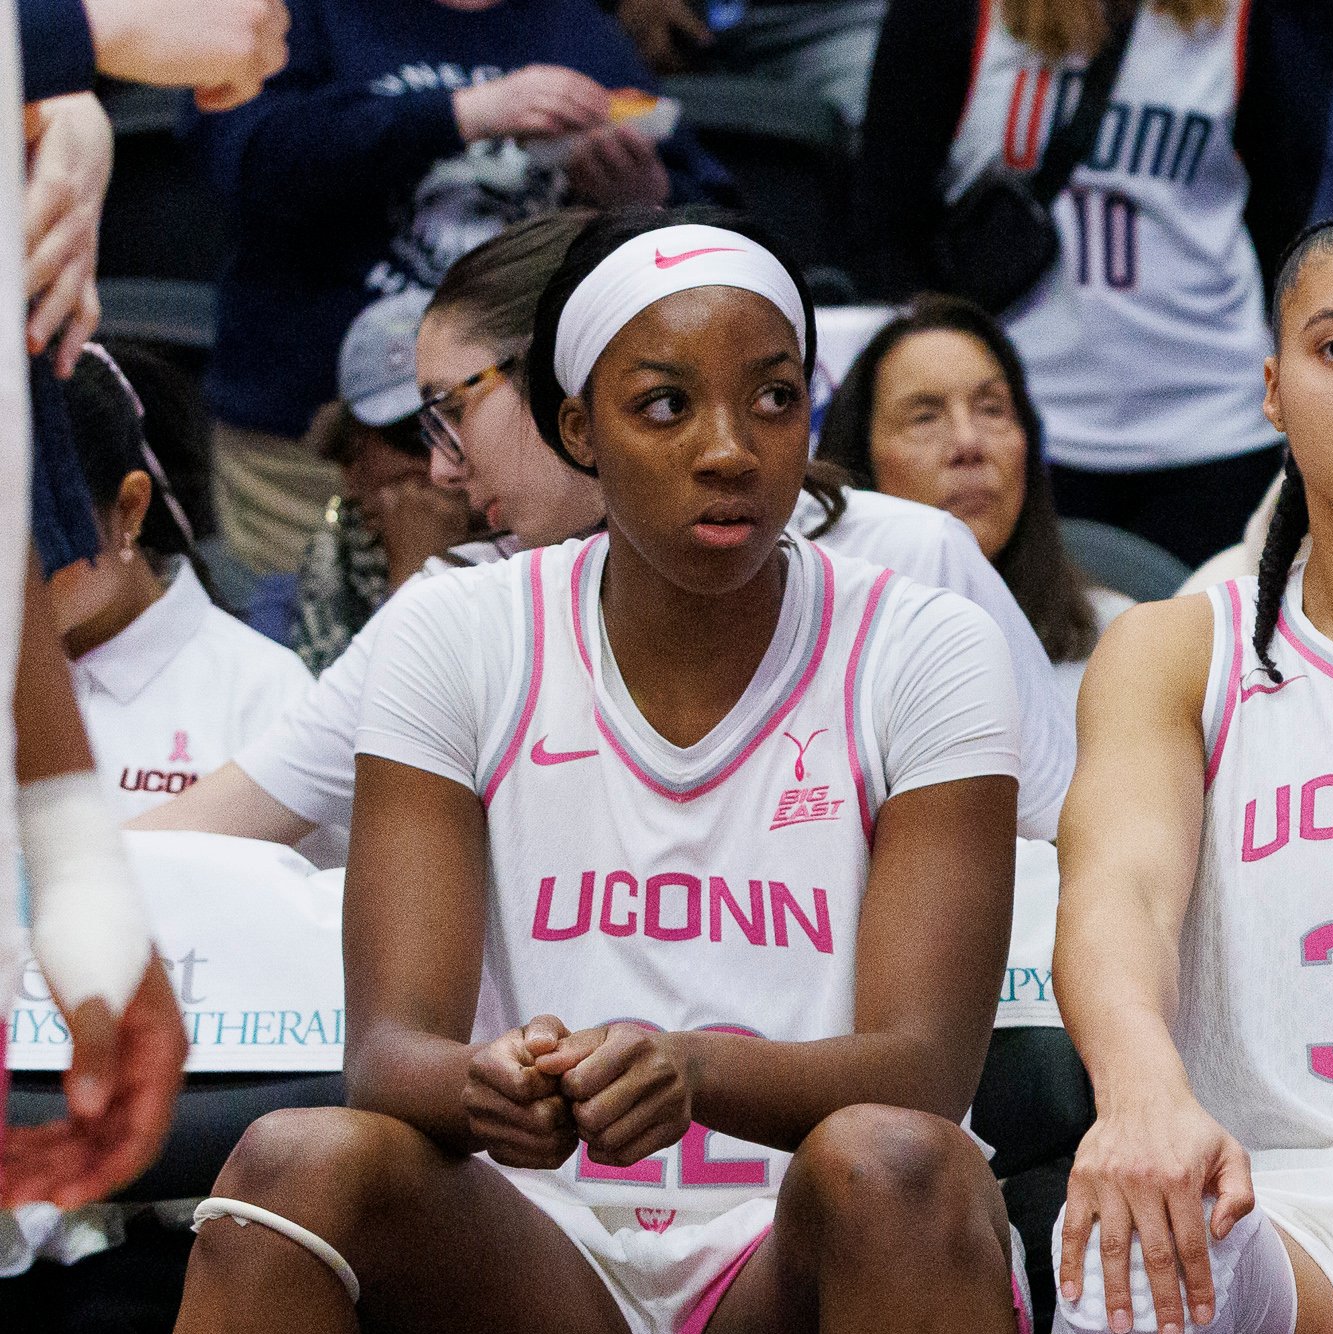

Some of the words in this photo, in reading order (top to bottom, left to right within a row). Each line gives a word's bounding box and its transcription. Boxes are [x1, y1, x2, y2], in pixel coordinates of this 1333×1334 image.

[120, 767, 199, 794] UCO
[779, 785, 830, 806] BIG
[772, 799, 845, 821] EAST
[532, 870, 834, 954] UCONN
